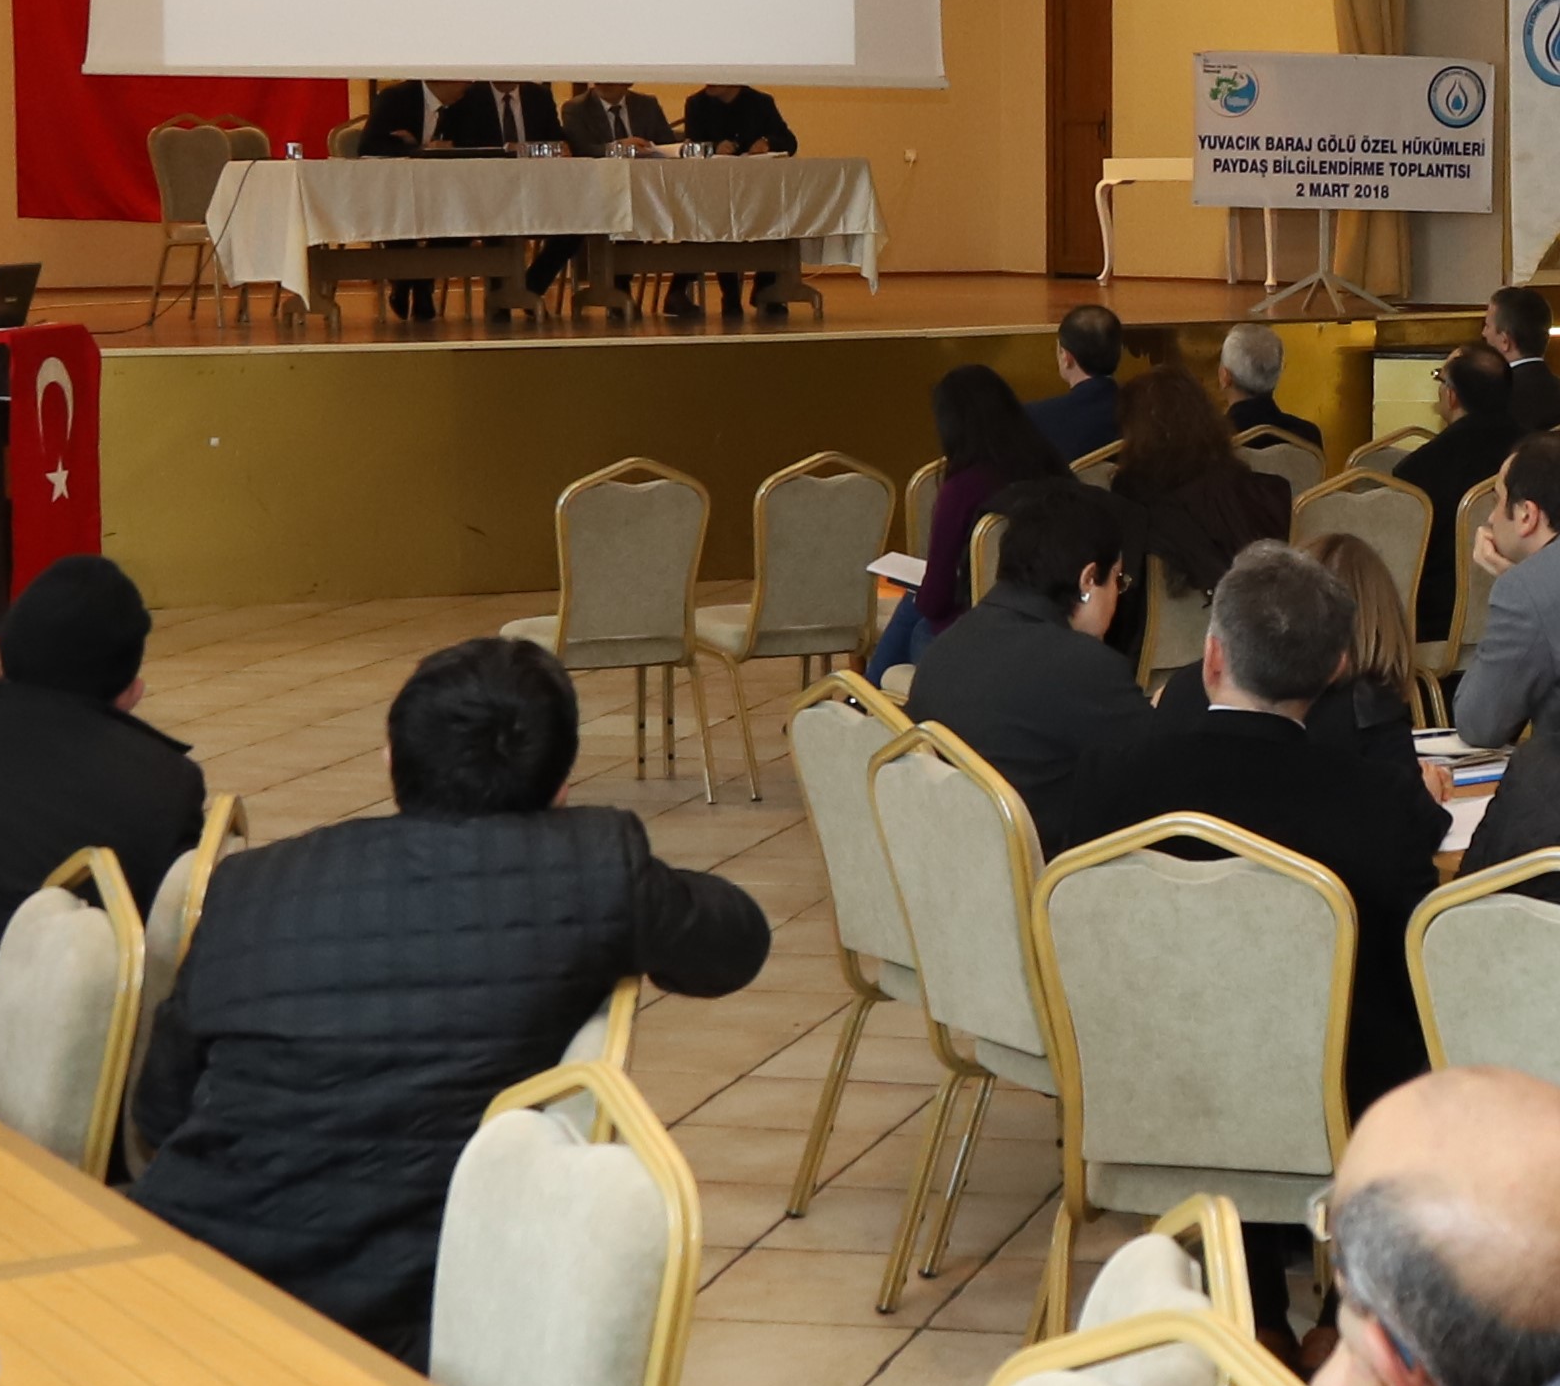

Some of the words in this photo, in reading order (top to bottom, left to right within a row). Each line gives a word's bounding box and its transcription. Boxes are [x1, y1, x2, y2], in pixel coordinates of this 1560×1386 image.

[1198, 135, 1260, 151] YUVACIK
[1265, 136, 1312, 152] BARAJ
[1317, 134, 1356, 153] GÖLÜ
[1360, 135, 1397, 154] ÖZEL
[1402, 136, 1485, 156] HÜKÜMLERİ
[1213, 158, 1268, 178] PAYDAŞ
[1273, 156, 1384, 176] BİLGİLENDİRME
[1389, 162, 1471, 179] TOPLANTISI
[1296, 182, 1305, 197] 2
[1309, 183, 1350, 198] MART
[1354, 184, 1389, 199] 2018
